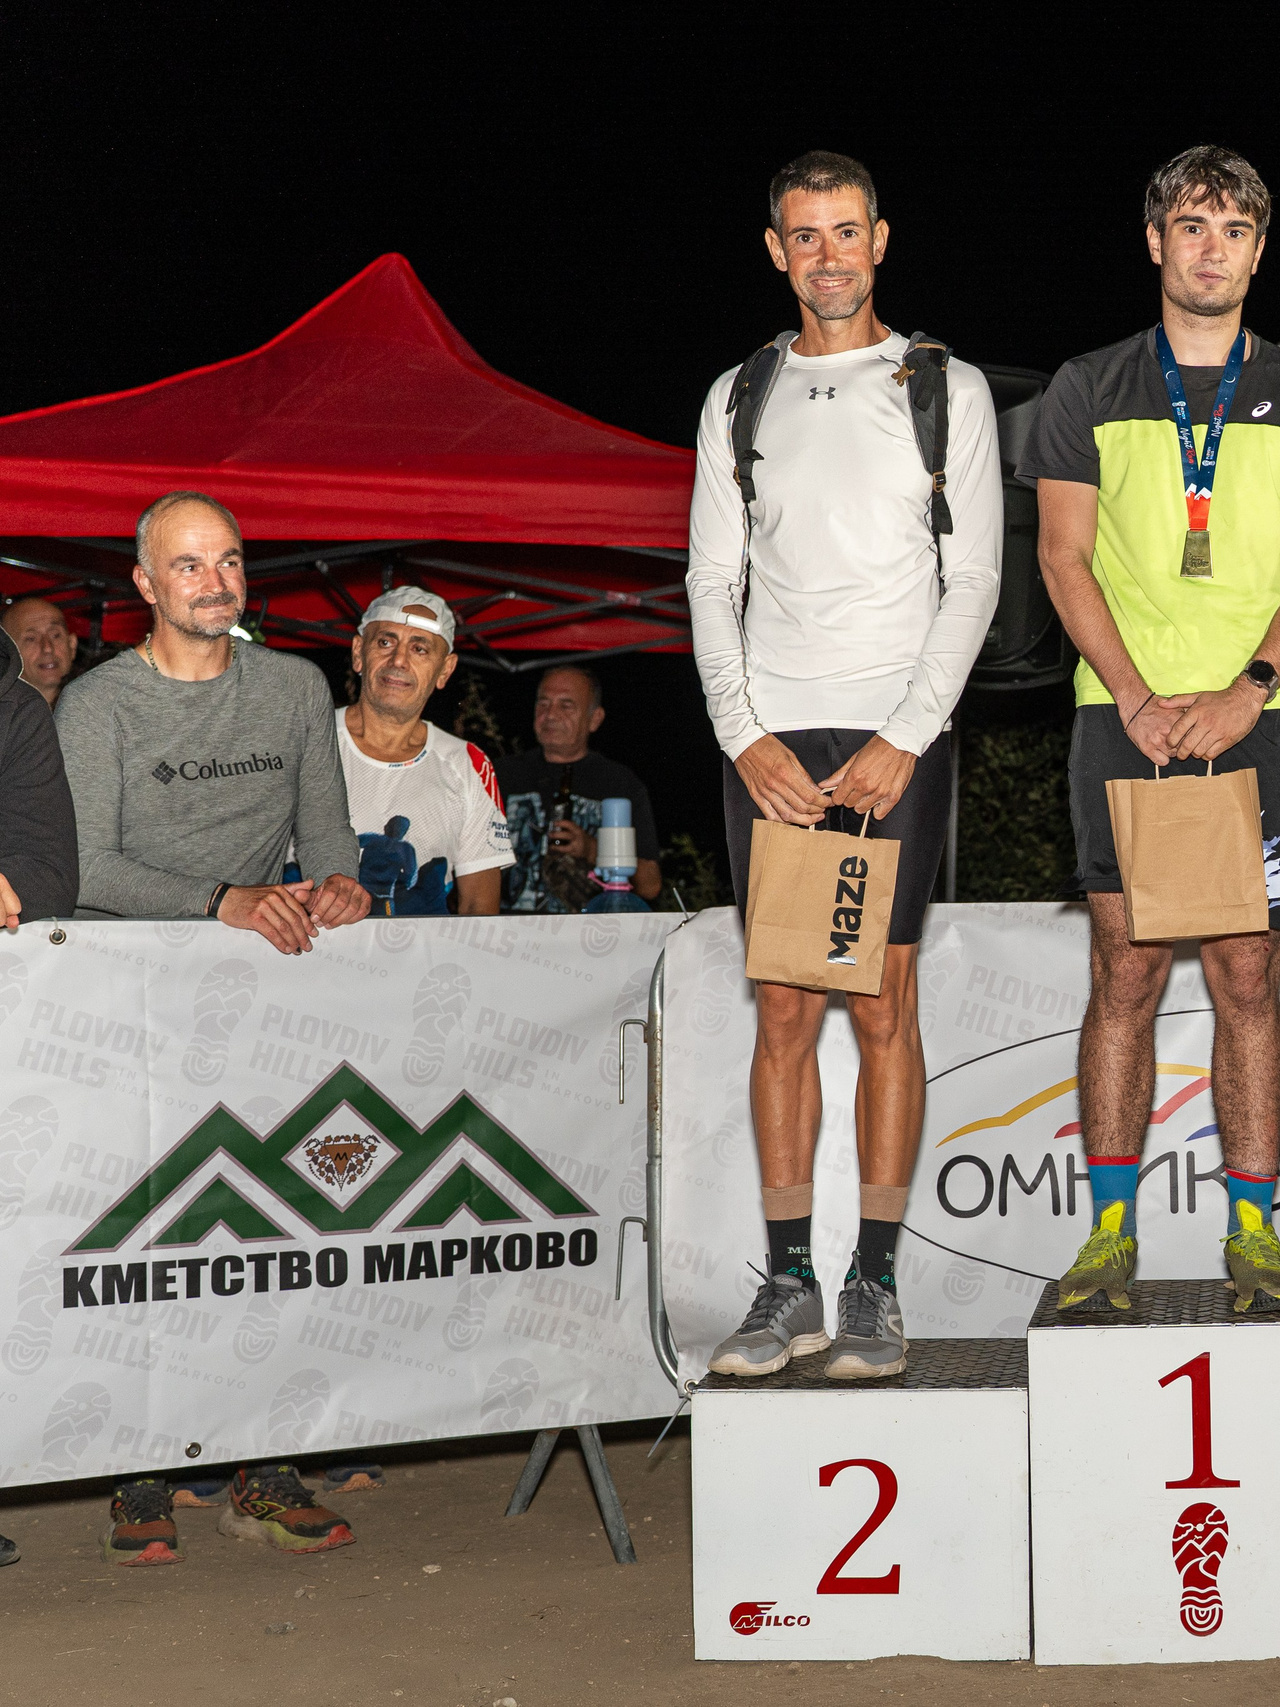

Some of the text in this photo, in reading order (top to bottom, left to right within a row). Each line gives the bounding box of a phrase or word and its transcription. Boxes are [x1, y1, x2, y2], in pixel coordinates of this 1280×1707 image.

[179, 752, 284, 781] Columbia
[29, 998, 171, 1063] PLOVDIV
[260, 1003, 390, 1066] PLOVDIV
[474, 1006, 590, 1066] PLOVDIV
[16, 1037, 112, 1089] HILLS
[462, 1042, 539, 1089] HILLS
[62, 1228, 598, 1310] КМЕТСТВО МАРКОВО
[298, 1314, 380, 1360] HILLS
[503, 1305, 583, 1349] HILLS
[1158, 1352, 1240, 1489] 1
[817, 1457, 902, 1596] 2
[733, 1614, 811, 1629] MILCO
